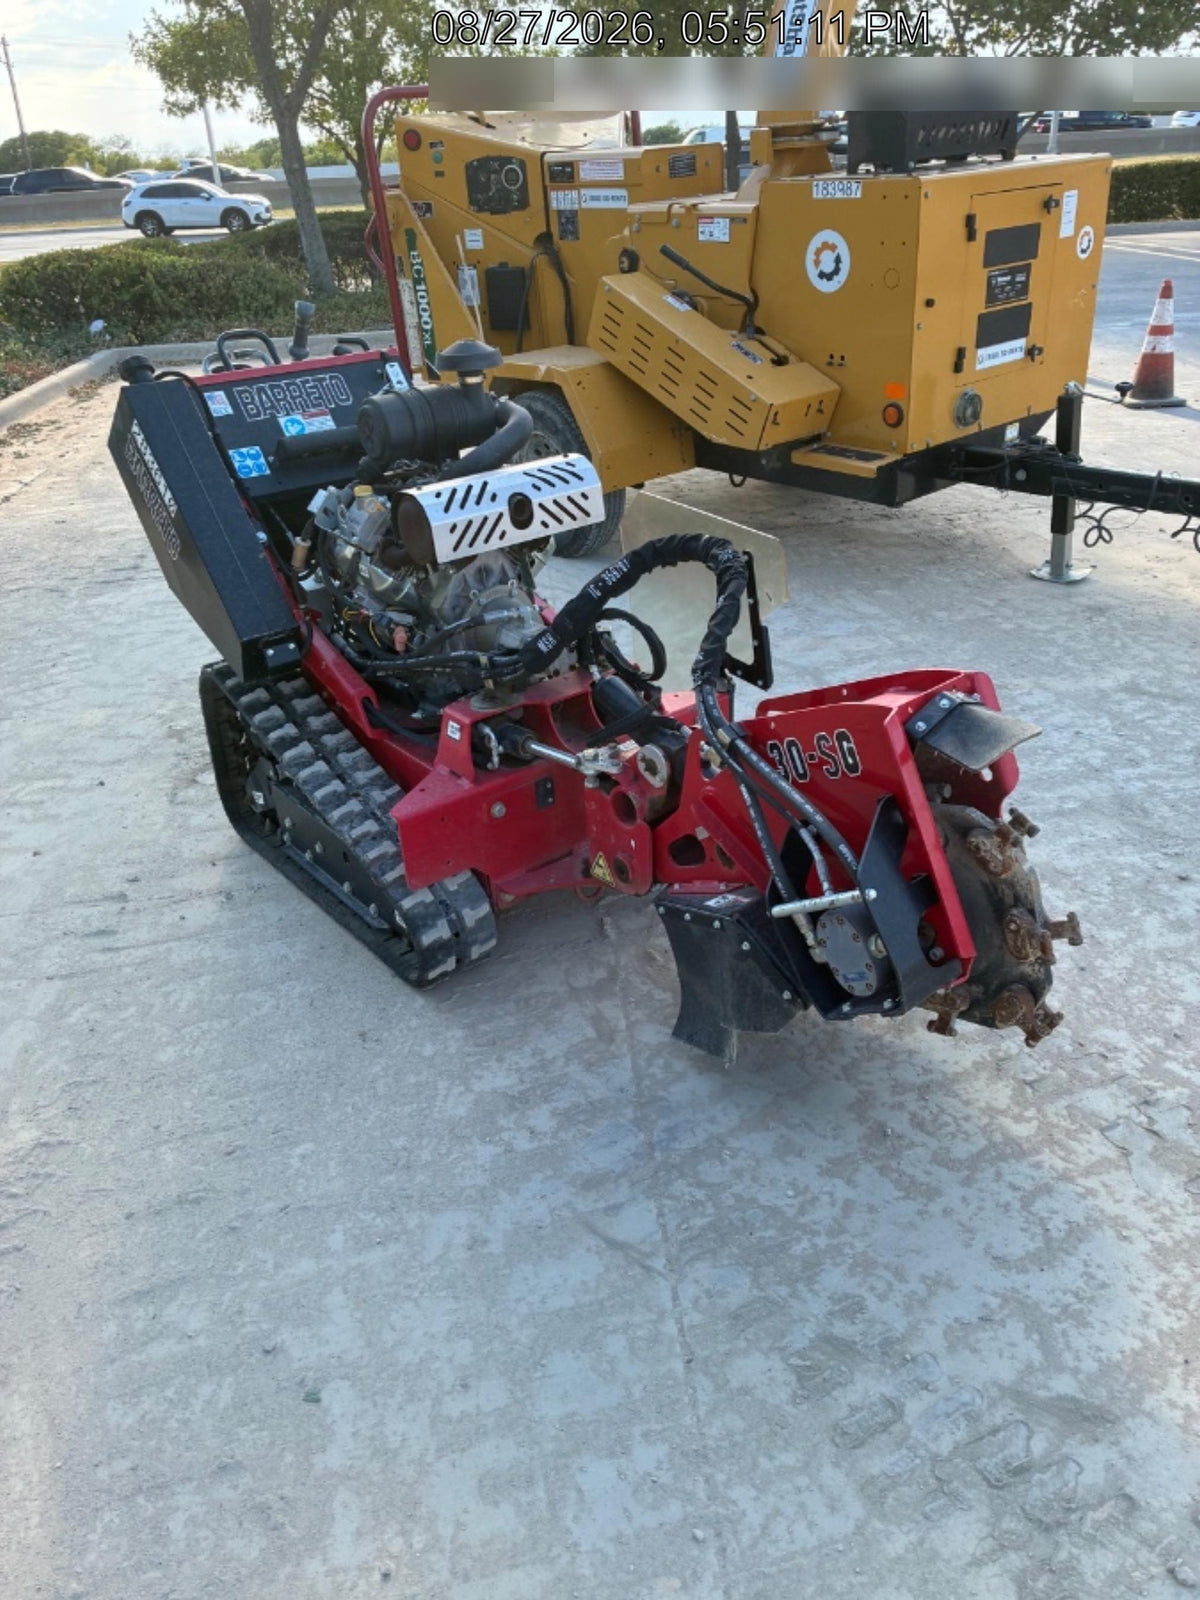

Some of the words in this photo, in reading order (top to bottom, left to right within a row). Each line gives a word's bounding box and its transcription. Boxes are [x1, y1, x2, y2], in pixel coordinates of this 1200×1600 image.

[814, 180, 862, 197] 183987
[233, 373, 352, 422] BARRETO
[766, 728, 862, 784] 30-SG
